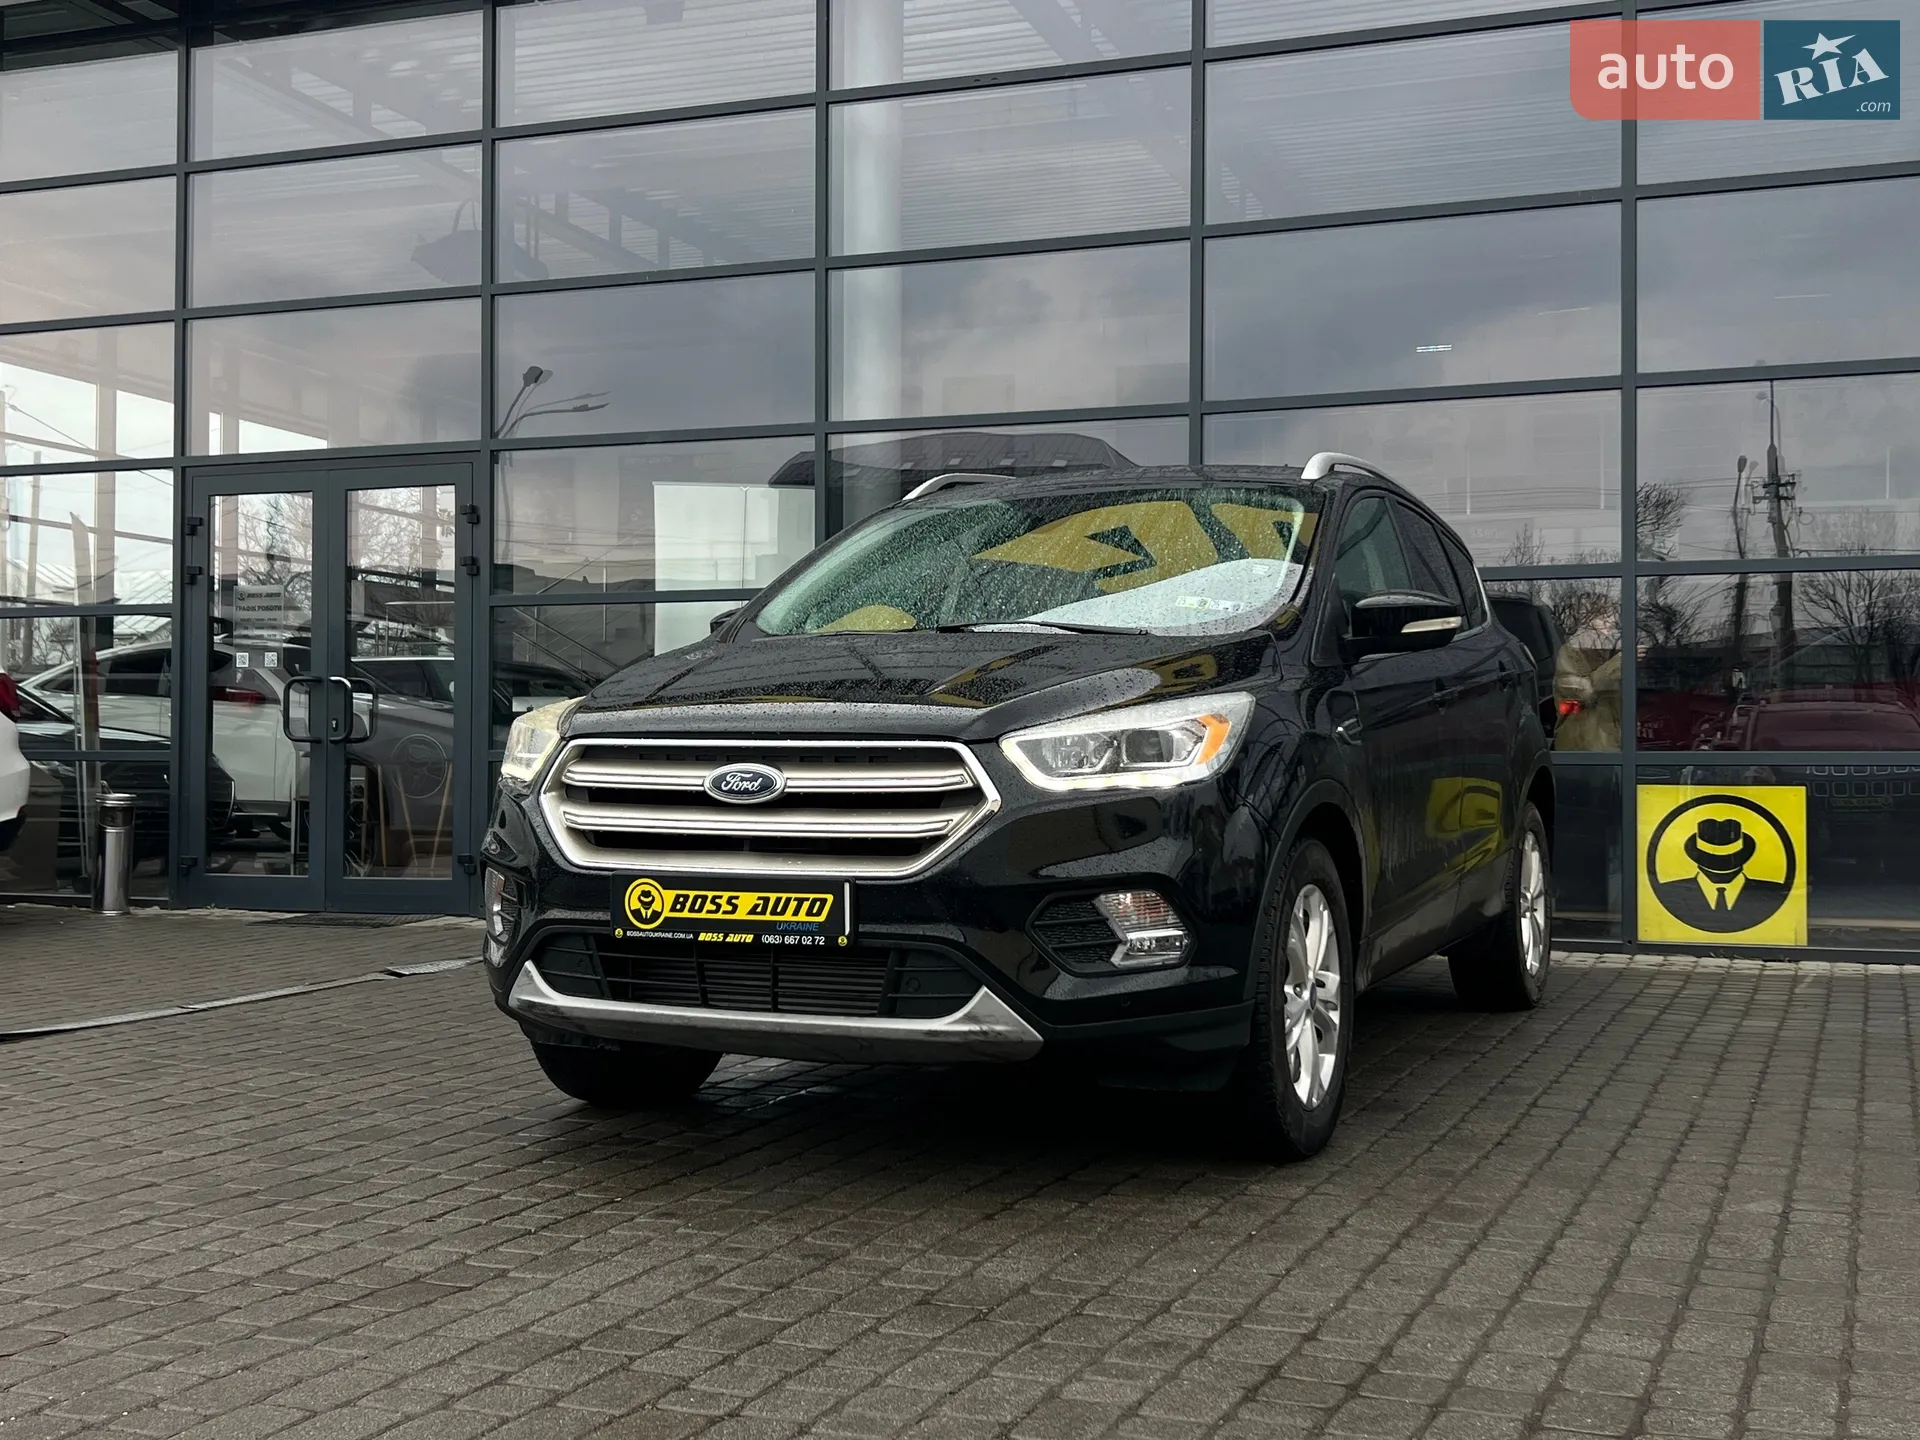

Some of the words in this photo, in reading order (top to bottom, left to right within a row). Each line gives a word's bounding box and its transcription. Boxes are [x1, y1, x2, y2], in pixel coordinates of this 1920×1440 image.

[721, 772, 763, 791] Ford
[668, 893, 741, 915] BOSS
[745, 896, 829, 917] AUTO
[776, 922, 820, 931] UKRAINE
[698, 932, 724, 942] BOSS
[725, 933, 754, 943] AUTO
[761, 934, 783, 944] (063)
[784, 935, 800, 944] 667
[801, 936, 813, 945] 02
[814, 936, 825, 945] 72
